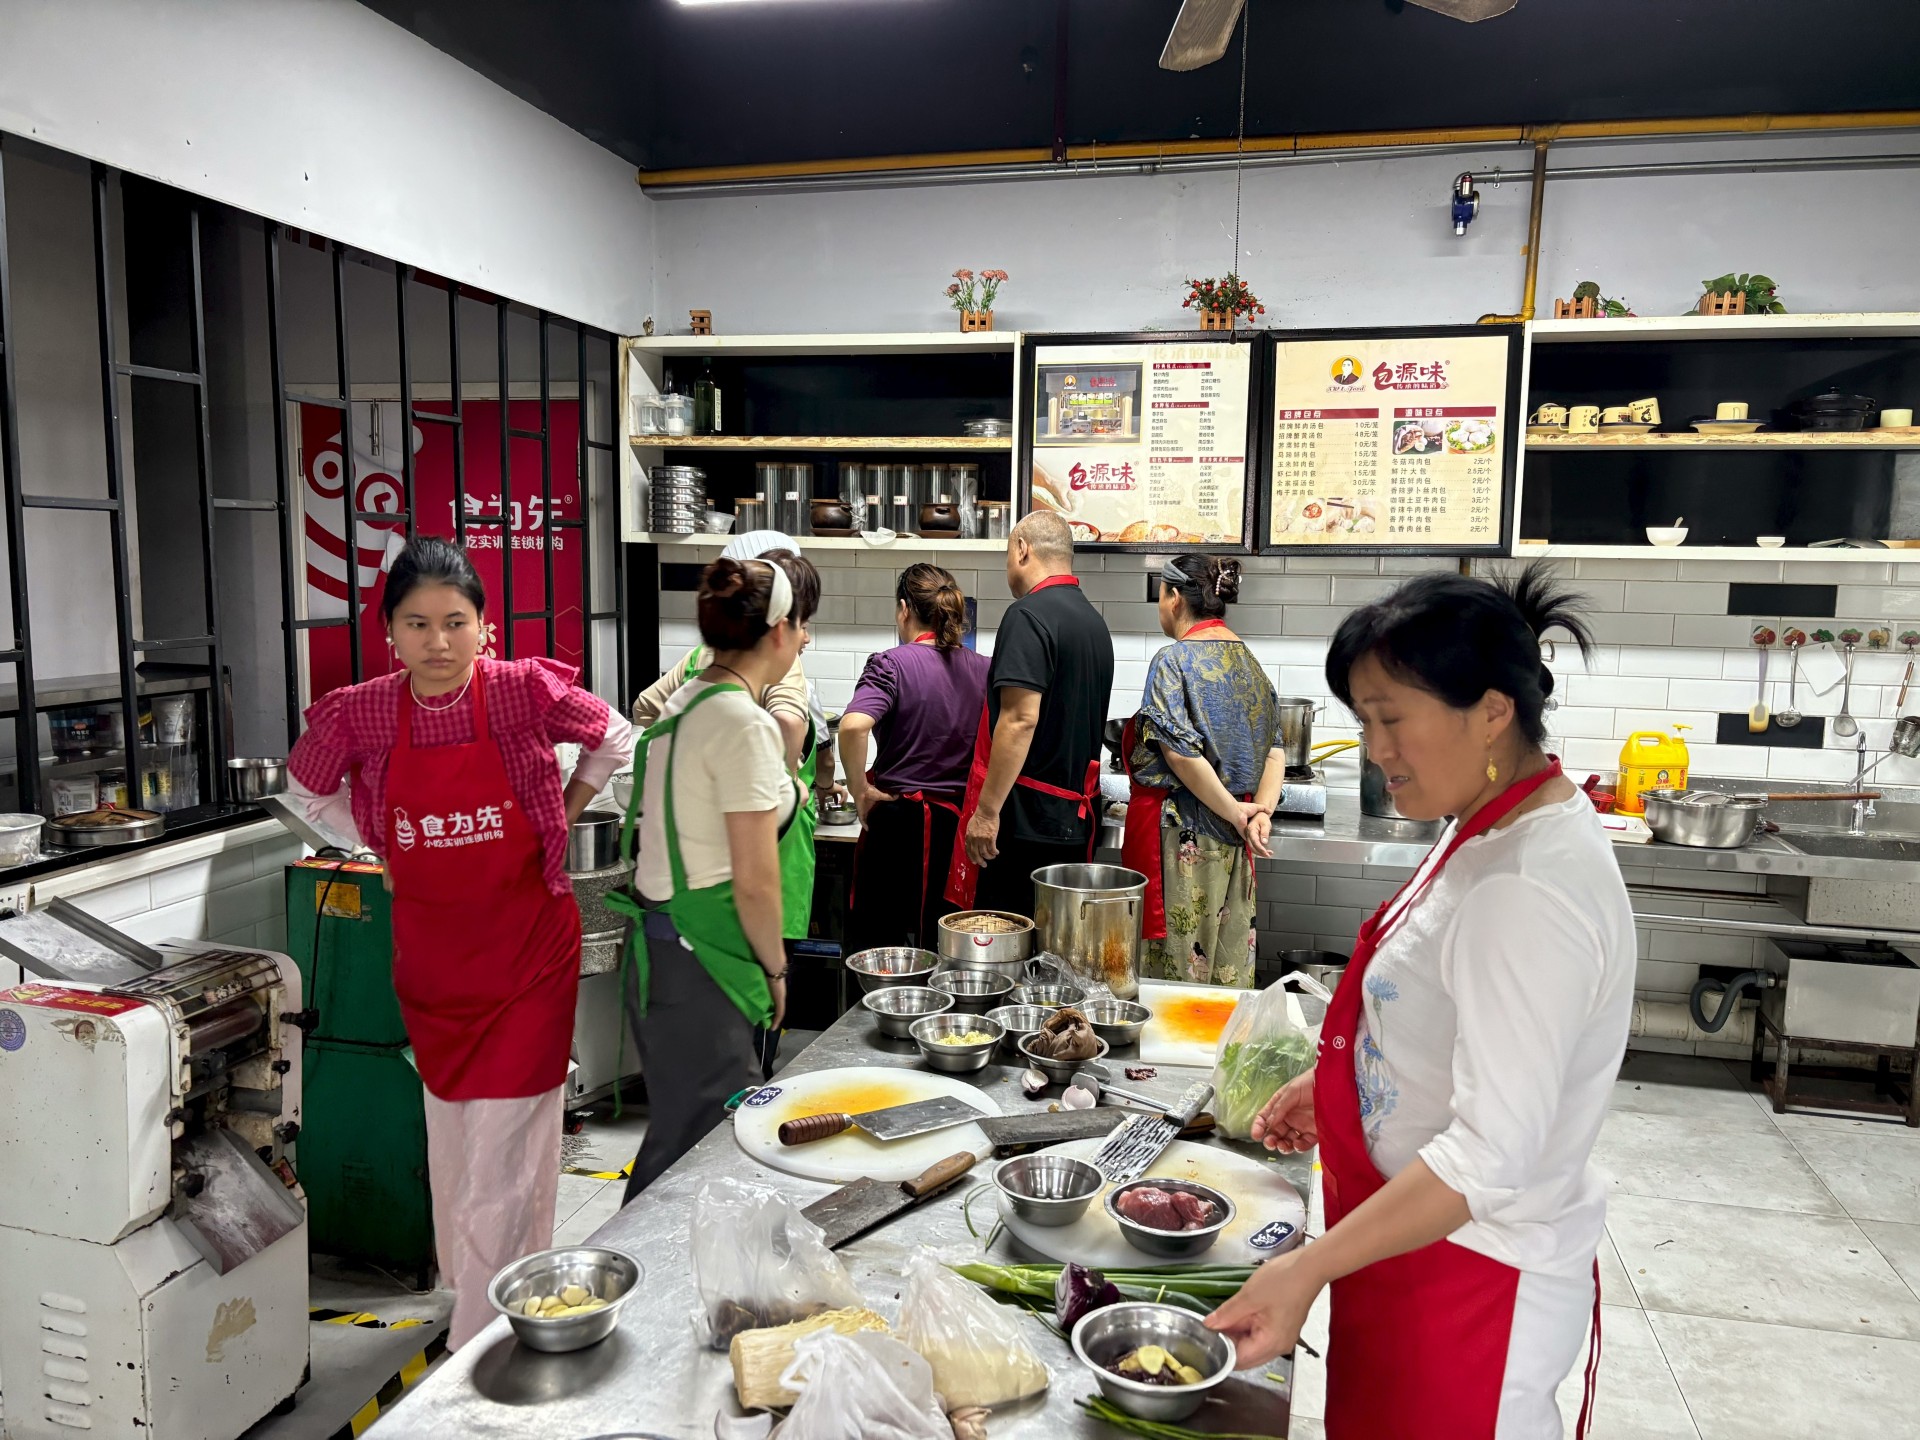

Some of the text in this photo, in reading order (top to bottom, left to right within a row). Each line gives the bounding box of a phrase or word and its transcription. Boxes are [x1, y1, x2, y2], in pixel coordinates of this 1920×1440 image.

[1373, 362, 1446, 390] 包源味
[1069, 462, 1135, 490] 包源味
[449, 493, 562, 531] 食为先
[450, 535, 563, 550] 吃实训连锁机构
[419, 805, 502, 837] 食为先
[424, 830, 503, 848] 小吃实训连锁机构
